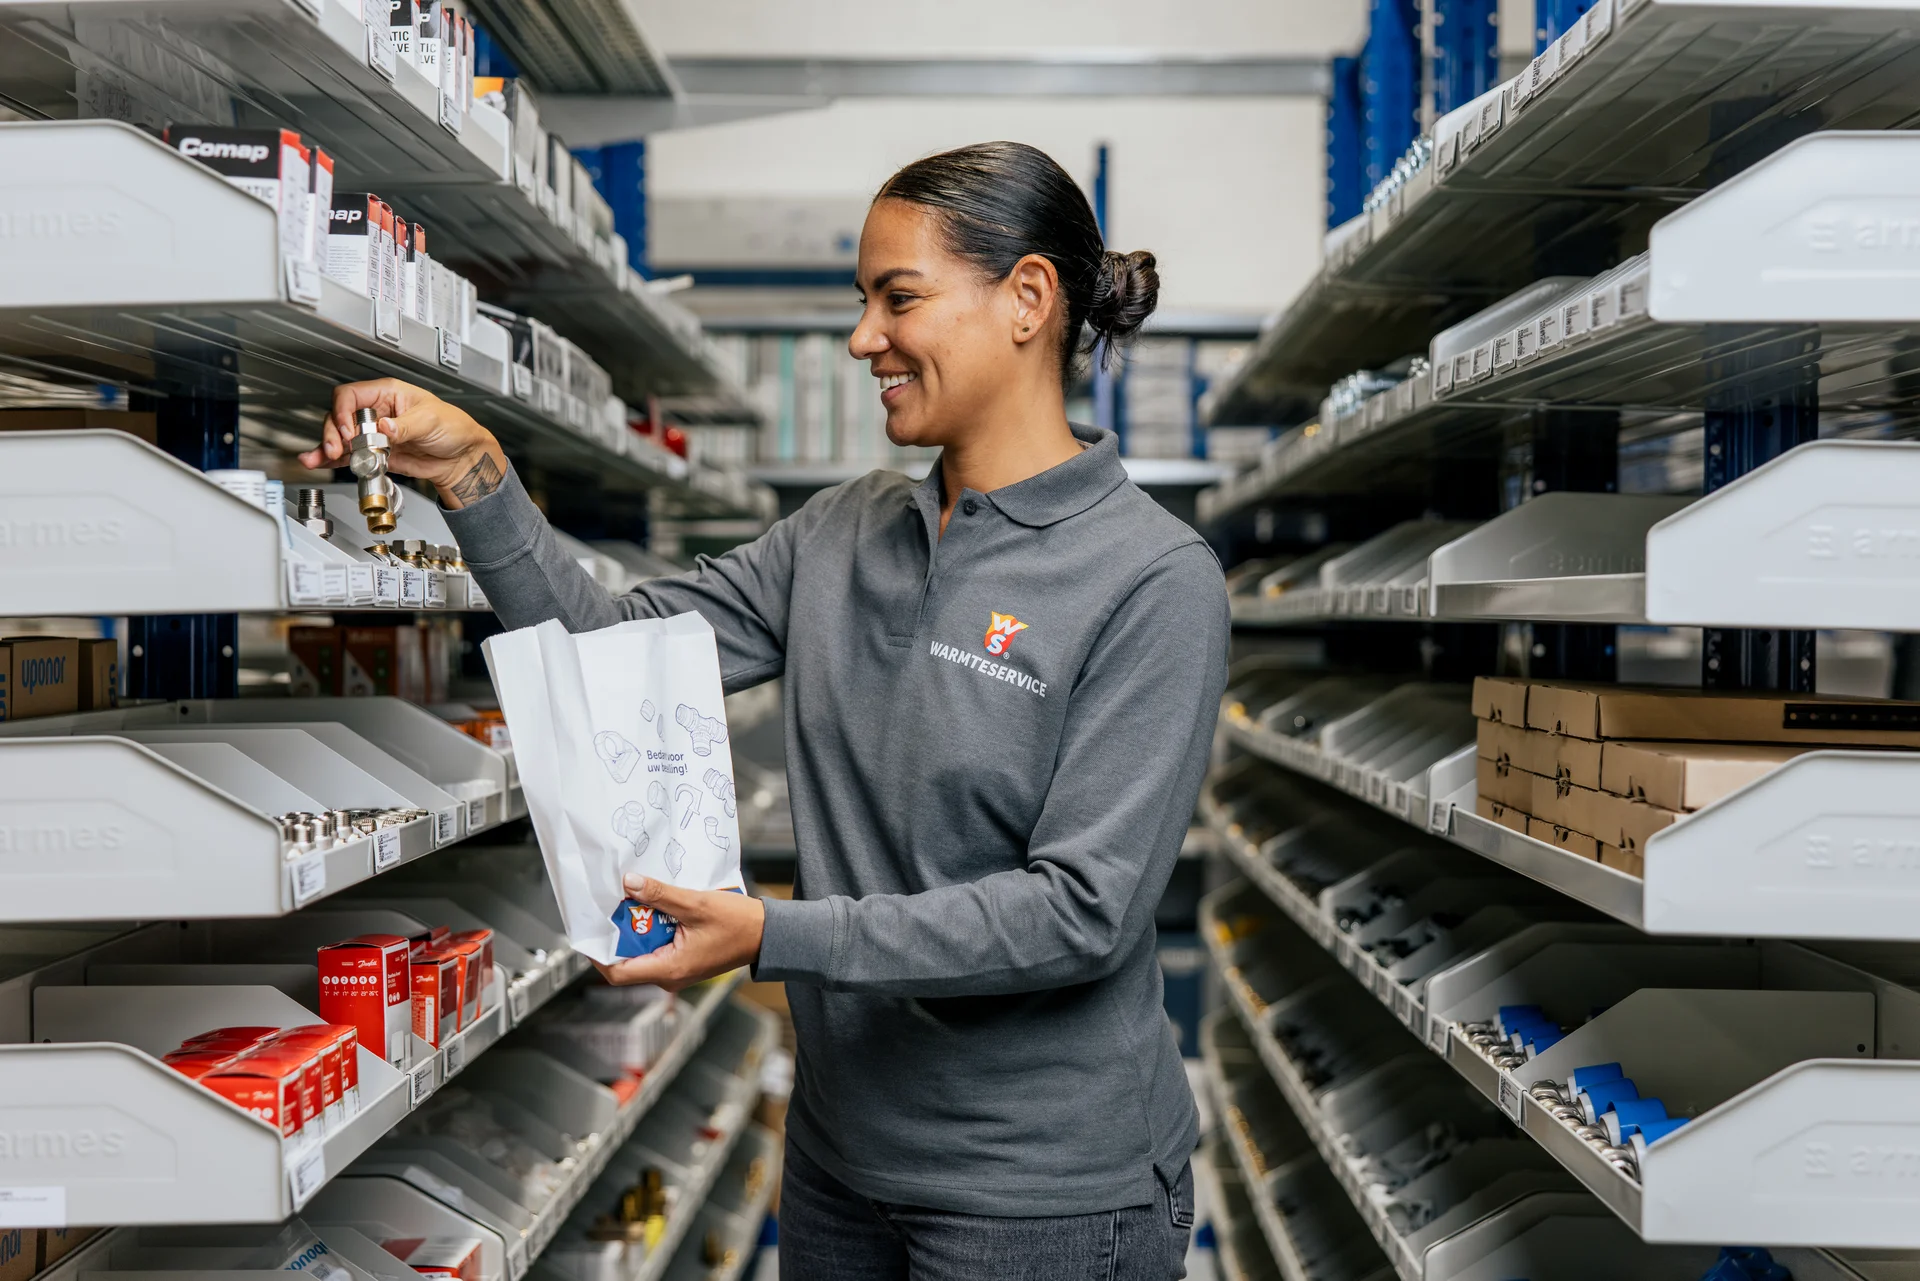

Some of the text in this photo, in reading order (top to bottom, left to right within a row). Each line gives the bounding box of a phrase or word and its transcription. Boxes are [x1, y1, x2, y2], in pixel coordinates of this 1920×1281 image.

[179, 137, 269, 162] Comap
[22, 656, 66, 695] uponor
[930, 641, 1048, 698] WARMTESERVICE
[647, 764, 660, 772] uw
